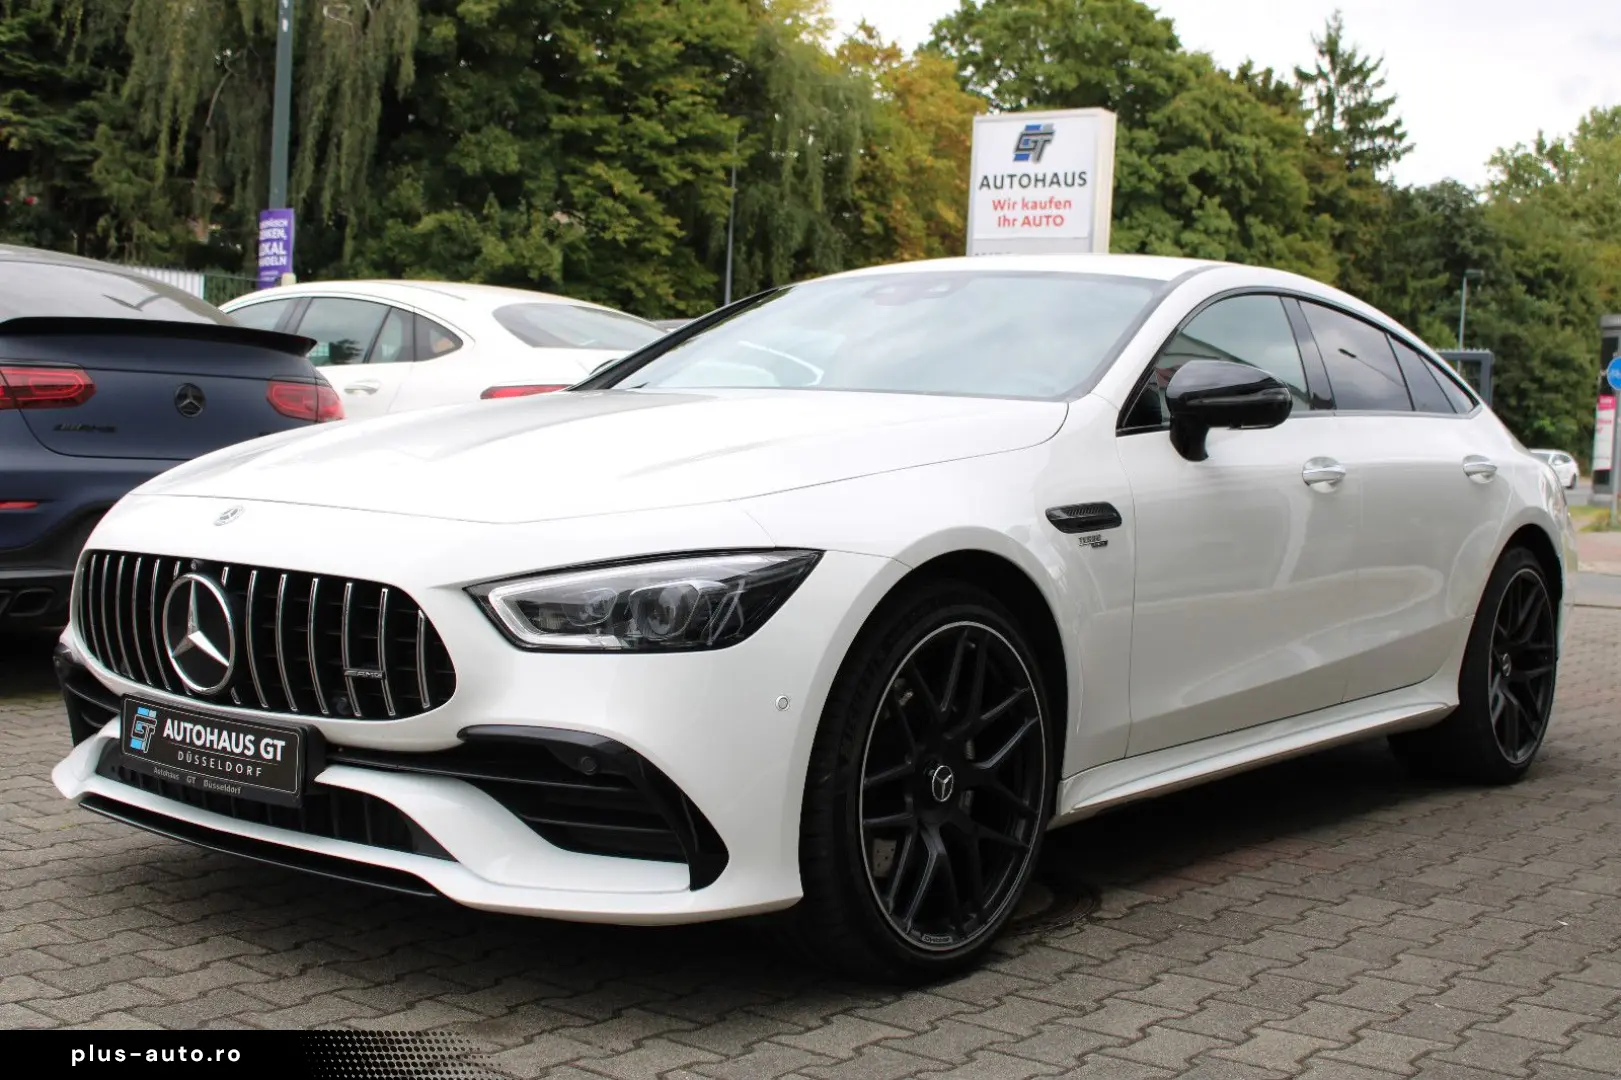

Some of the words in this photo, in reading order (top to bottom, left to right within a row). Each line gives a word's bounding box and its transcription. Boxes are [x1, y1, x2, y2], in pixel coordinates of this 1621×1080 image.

[978, 171, 1087, 190] AUTOHAUS
[992, 198, 1017, 211] Wir
[1021, 196, 1072, 211] kaufen
[997, 215, 1017, 228] Ihr
[1020, 215, 1065, 228] AUTO
[163, 718, 255, 756] AUTOHAUS
[259, 738, 286, 761] GT
[178, 751, 262, 777] DÜSSELDORF
[153, 767, 181, 781] Autohaus
[186, 775, 197, 785] GT
